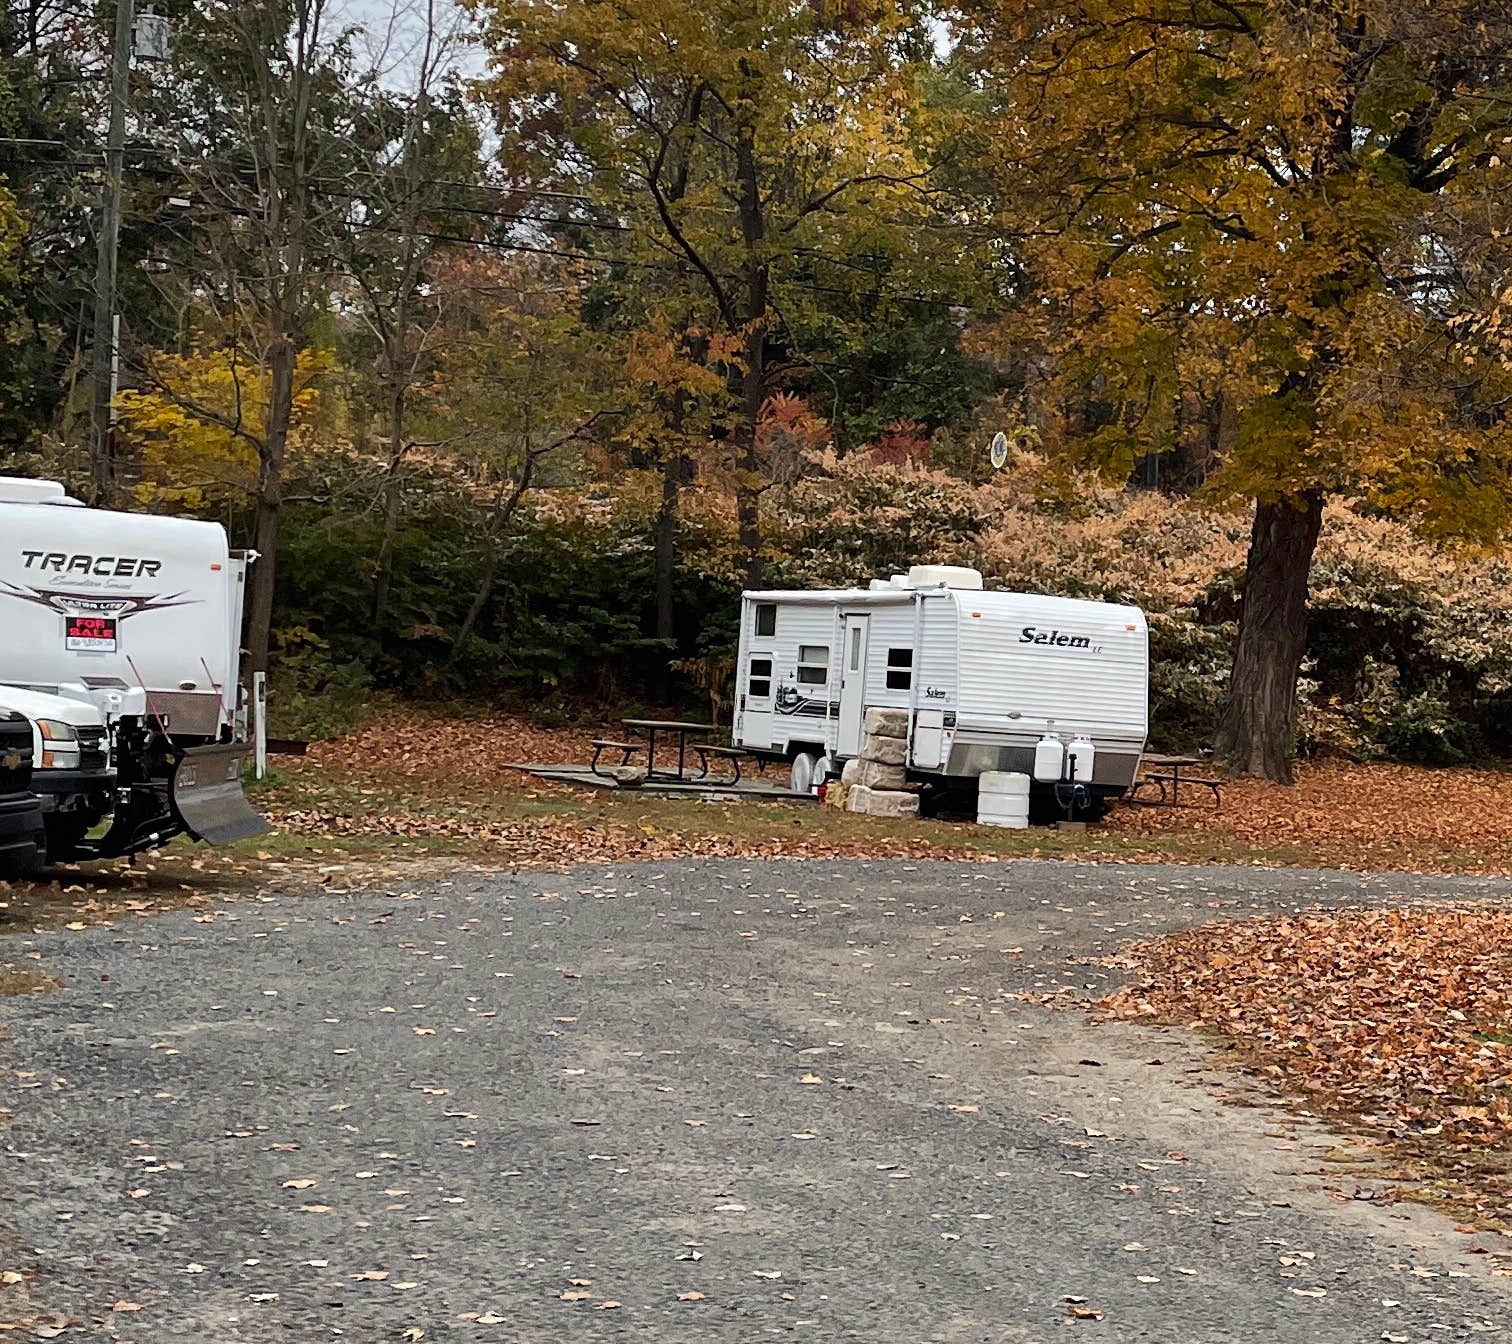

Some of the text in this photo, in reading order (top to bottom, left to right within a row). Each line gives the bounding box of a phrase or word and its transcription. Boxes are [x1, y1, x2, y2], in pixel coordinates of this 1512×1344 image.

[22, 550, 162, 578] TRACER
[76, 618, 105, 628] FOR
[69, 627, 113, 638] SALE
[1019, 627, 1090, 648] Salem
